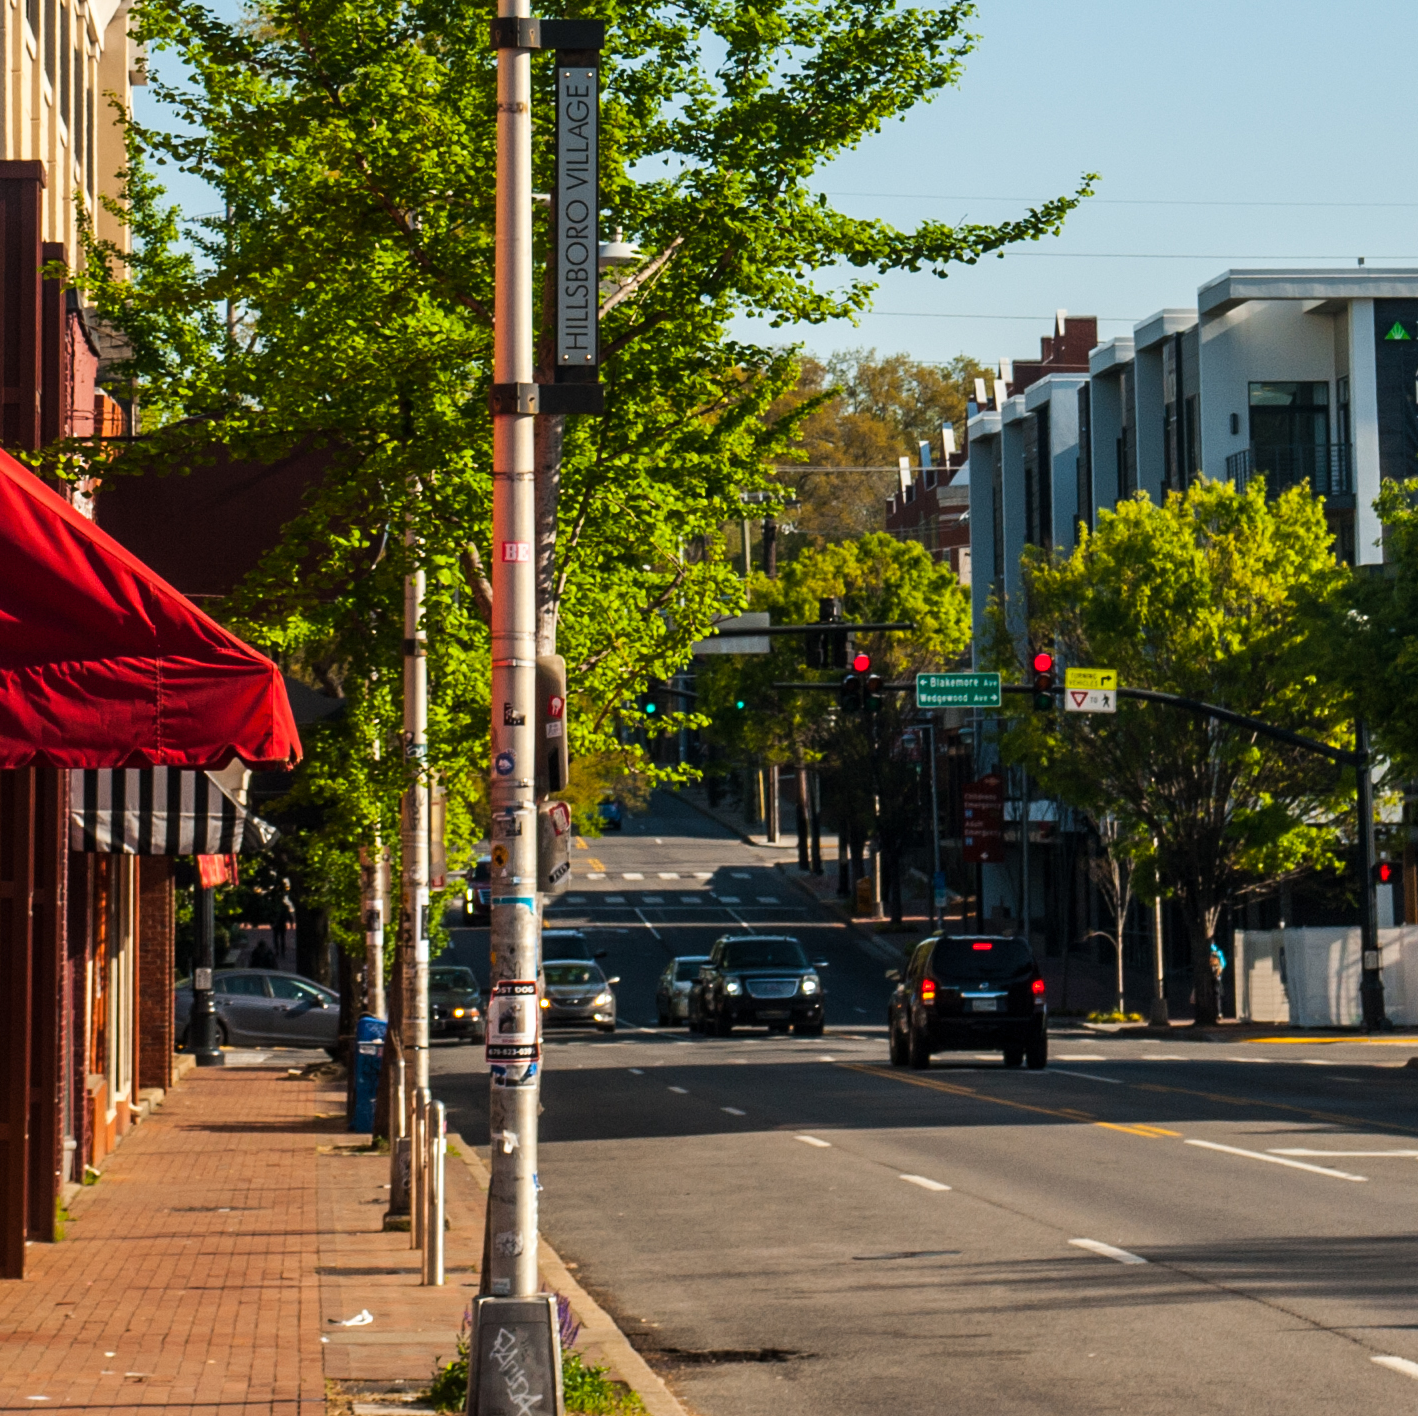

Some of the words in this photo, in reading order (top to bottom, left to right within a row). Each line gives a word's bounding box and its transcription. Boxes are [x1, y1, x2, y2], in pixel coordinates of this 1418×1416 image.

[566, 84, 590, 192] VILLAGE
[566, 198, 589, 351] HILLSBORO
[930, 677, 979, 688] Blakemore
[983, 679, 998, 687] Ave
[920, 693, 968, 705] Wedgewood
[973, 694, 988, 702] Ave
[514, 986, 534, 994] DOG
